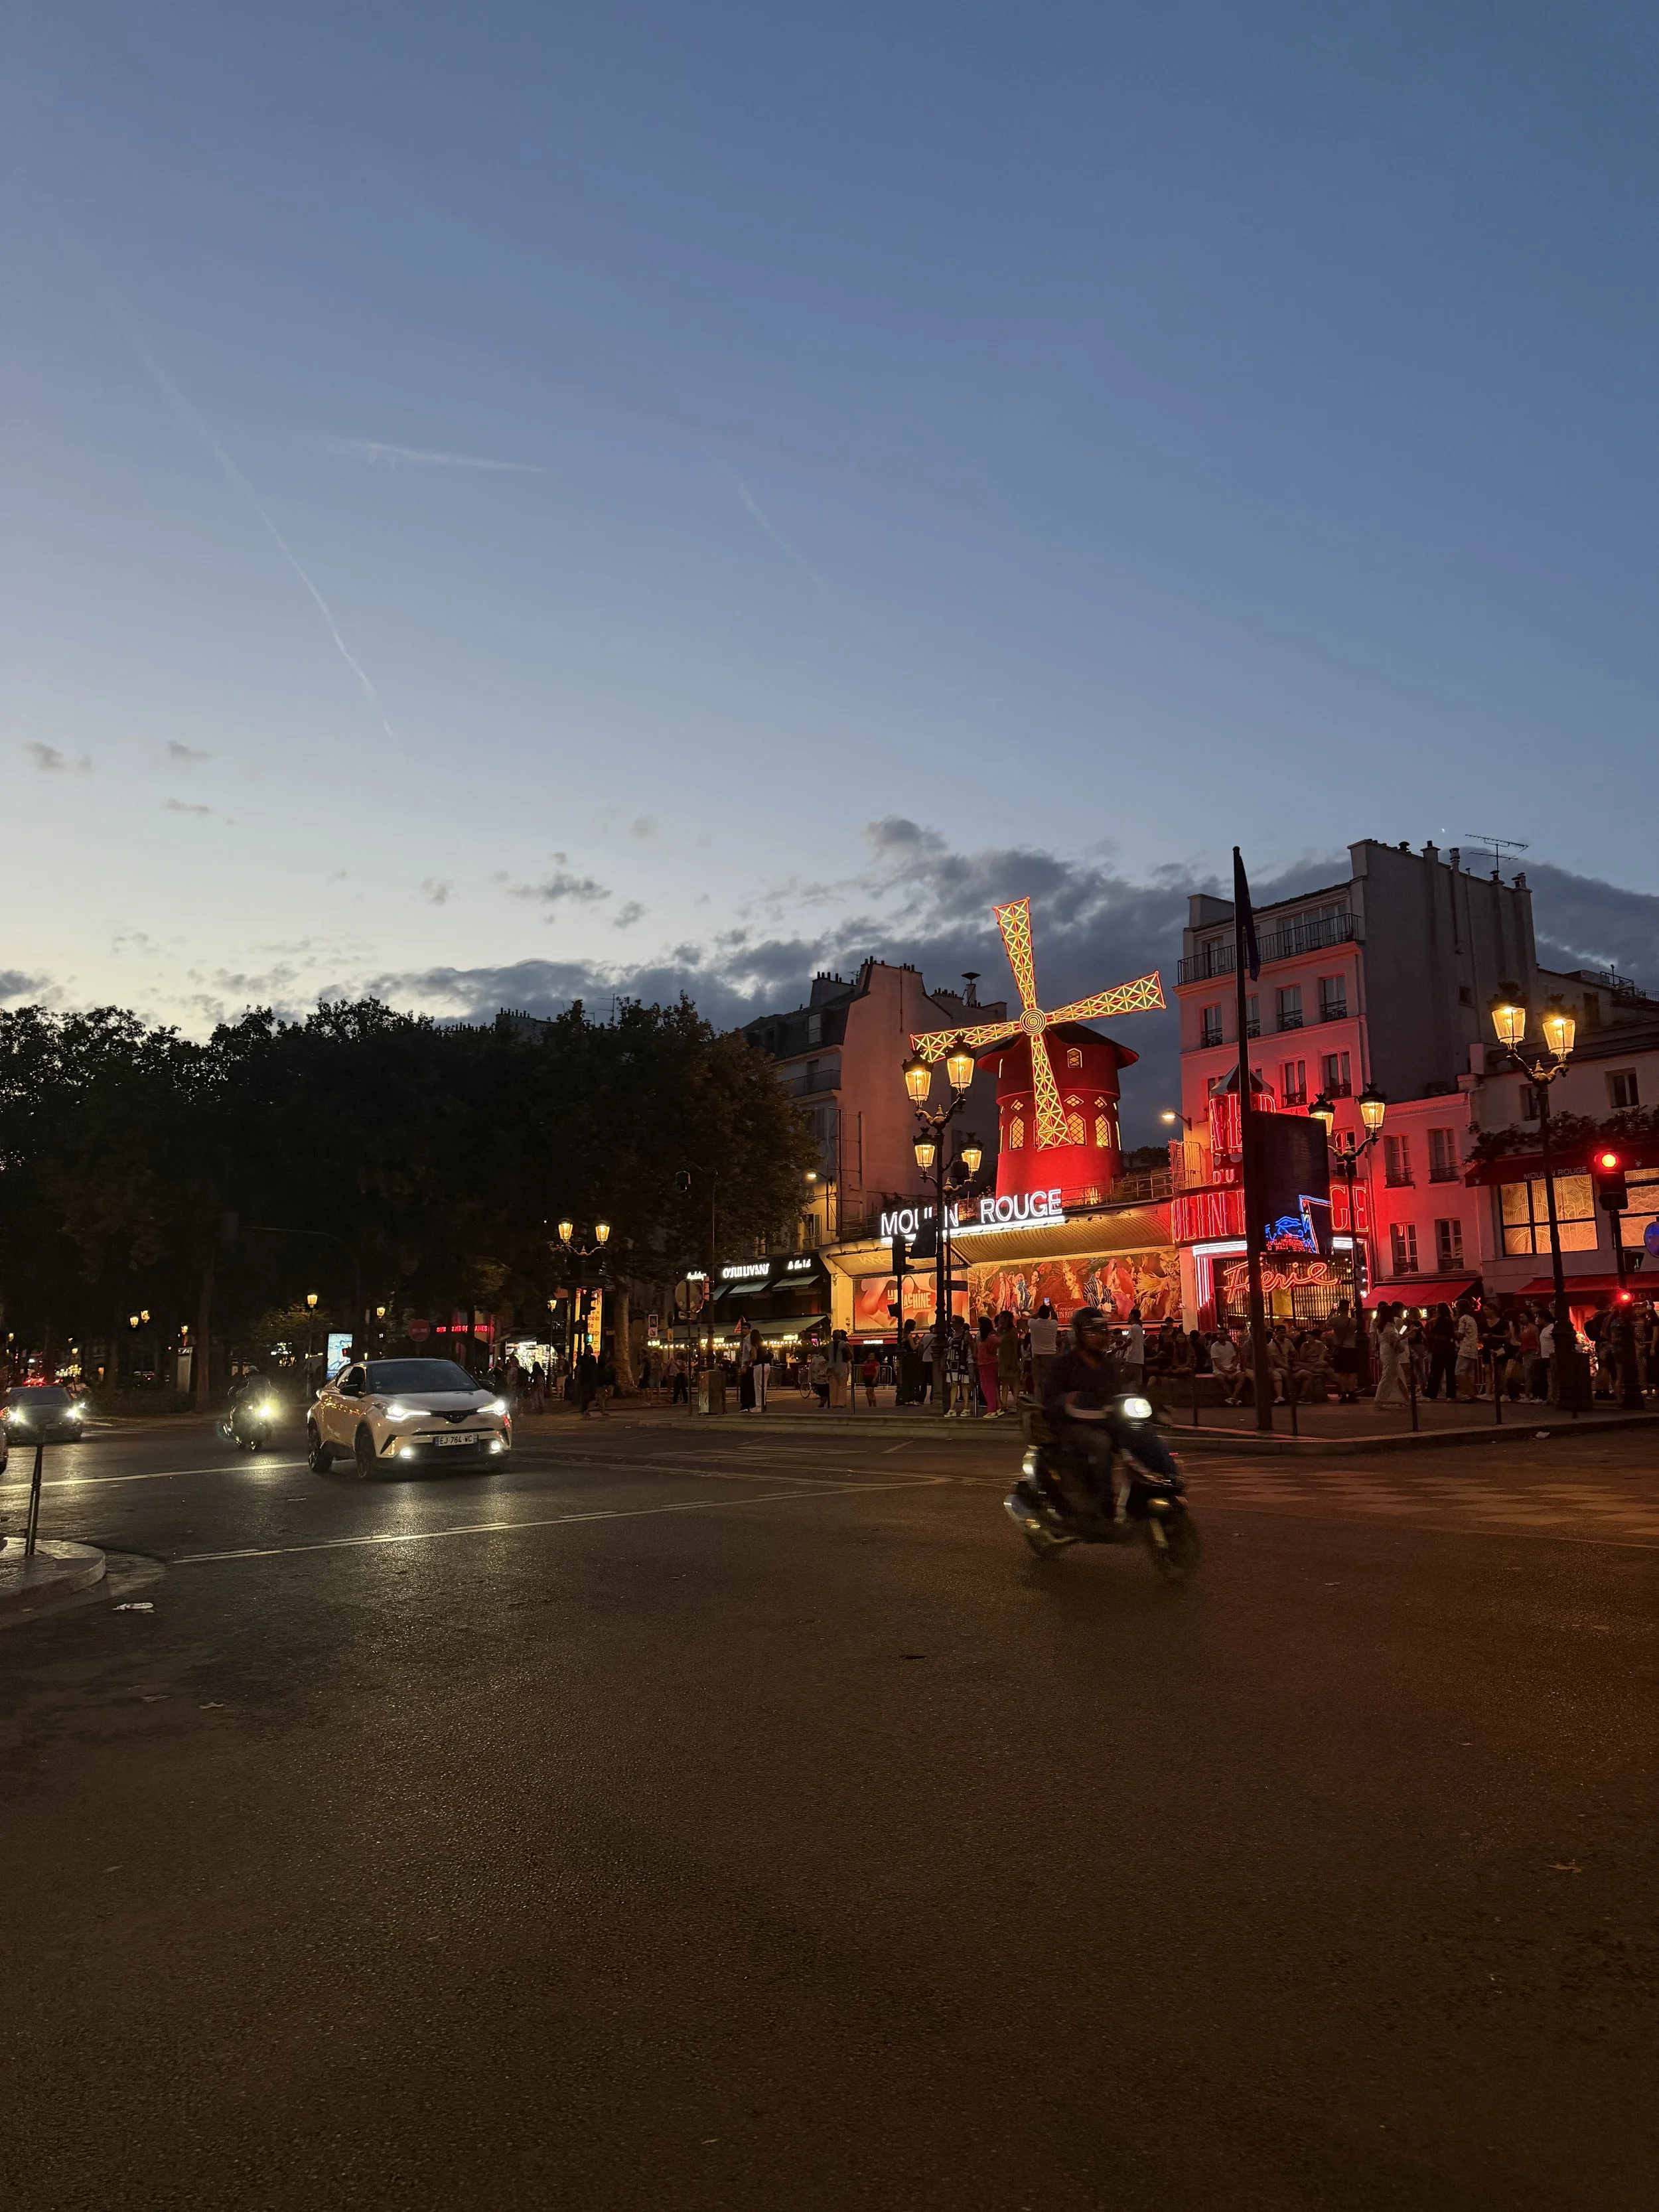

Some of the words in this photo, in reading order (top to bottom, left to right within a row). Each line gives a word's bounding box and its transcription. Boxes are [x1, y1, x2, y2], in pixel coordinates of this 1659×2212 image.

[1523, 1170, 1555, 1179] MOULN
[1557, 1166, 1587, 1175] ROUGE
[980, 1189, 1062, 1224] ROUGE
